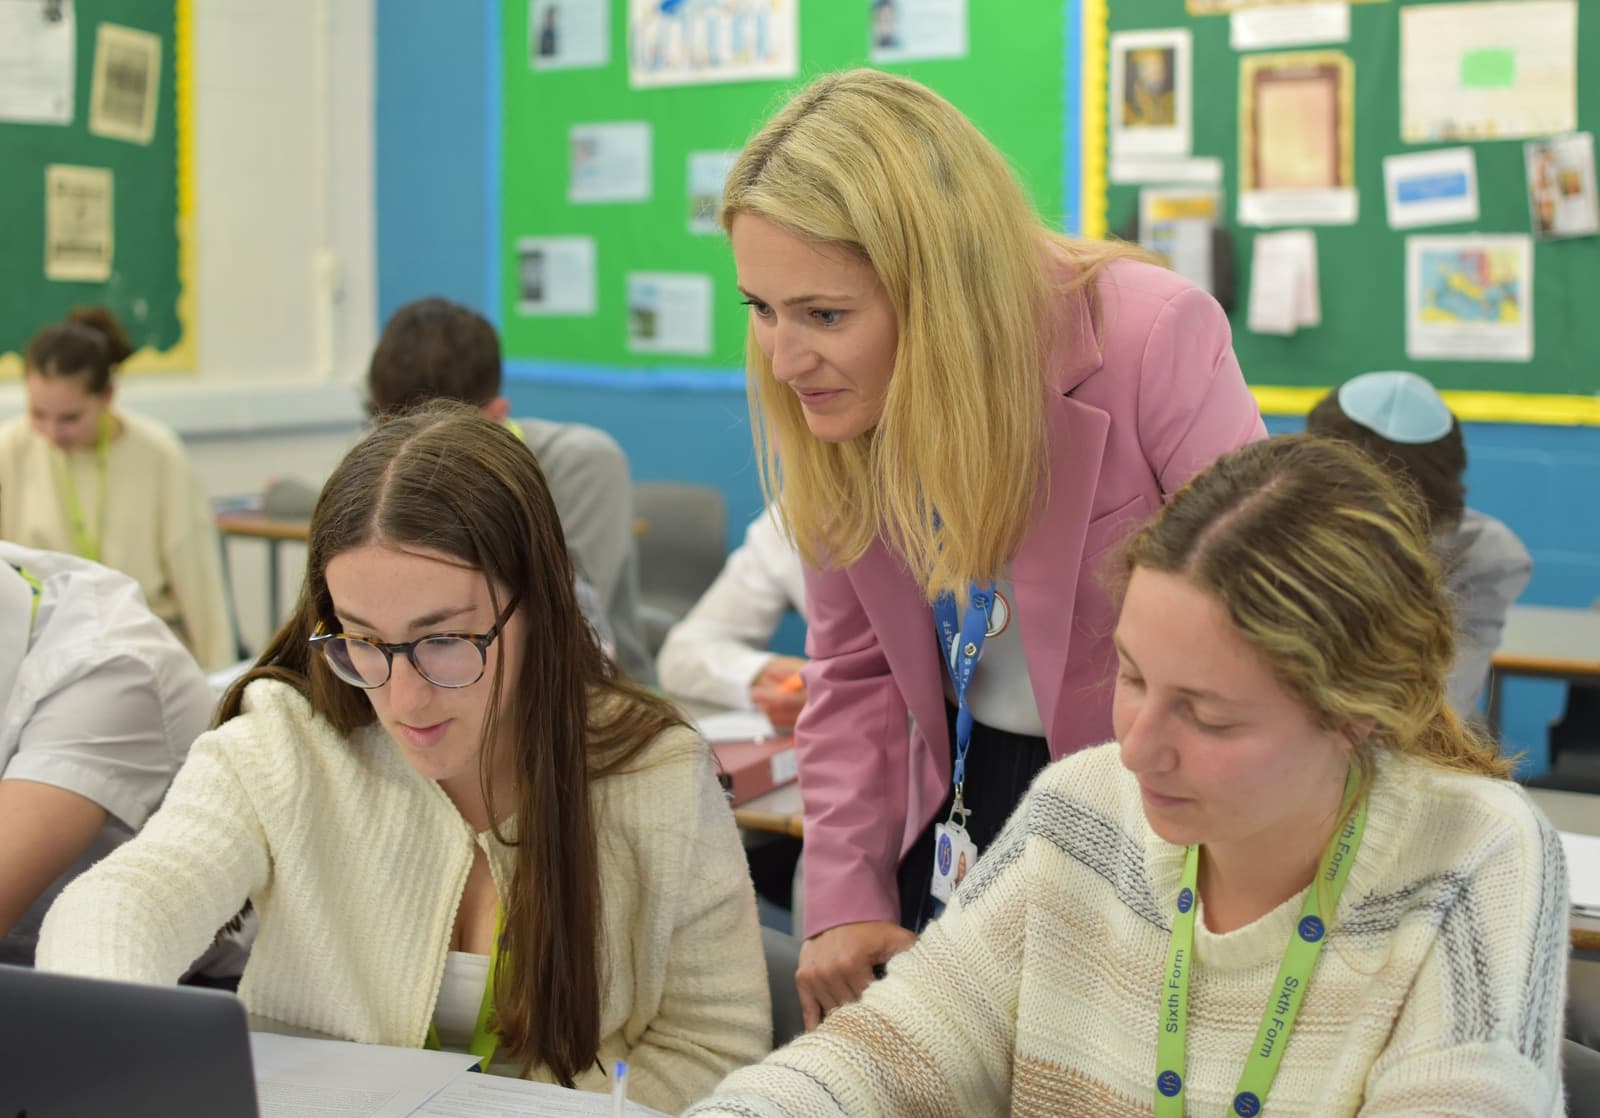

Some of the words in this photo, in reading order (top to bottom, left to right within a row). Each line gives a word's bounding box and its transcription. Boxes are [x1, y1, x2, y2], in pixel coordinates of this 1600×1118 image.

[1324, 841, 1351, 882] Form
[1169, 949, 1184, 989] Form
[1166, 994, 1179, 1033] Sixth
[1274, 976, 1299, 1015] Sixth
[1259, 1017, 1285, 1058] Form
